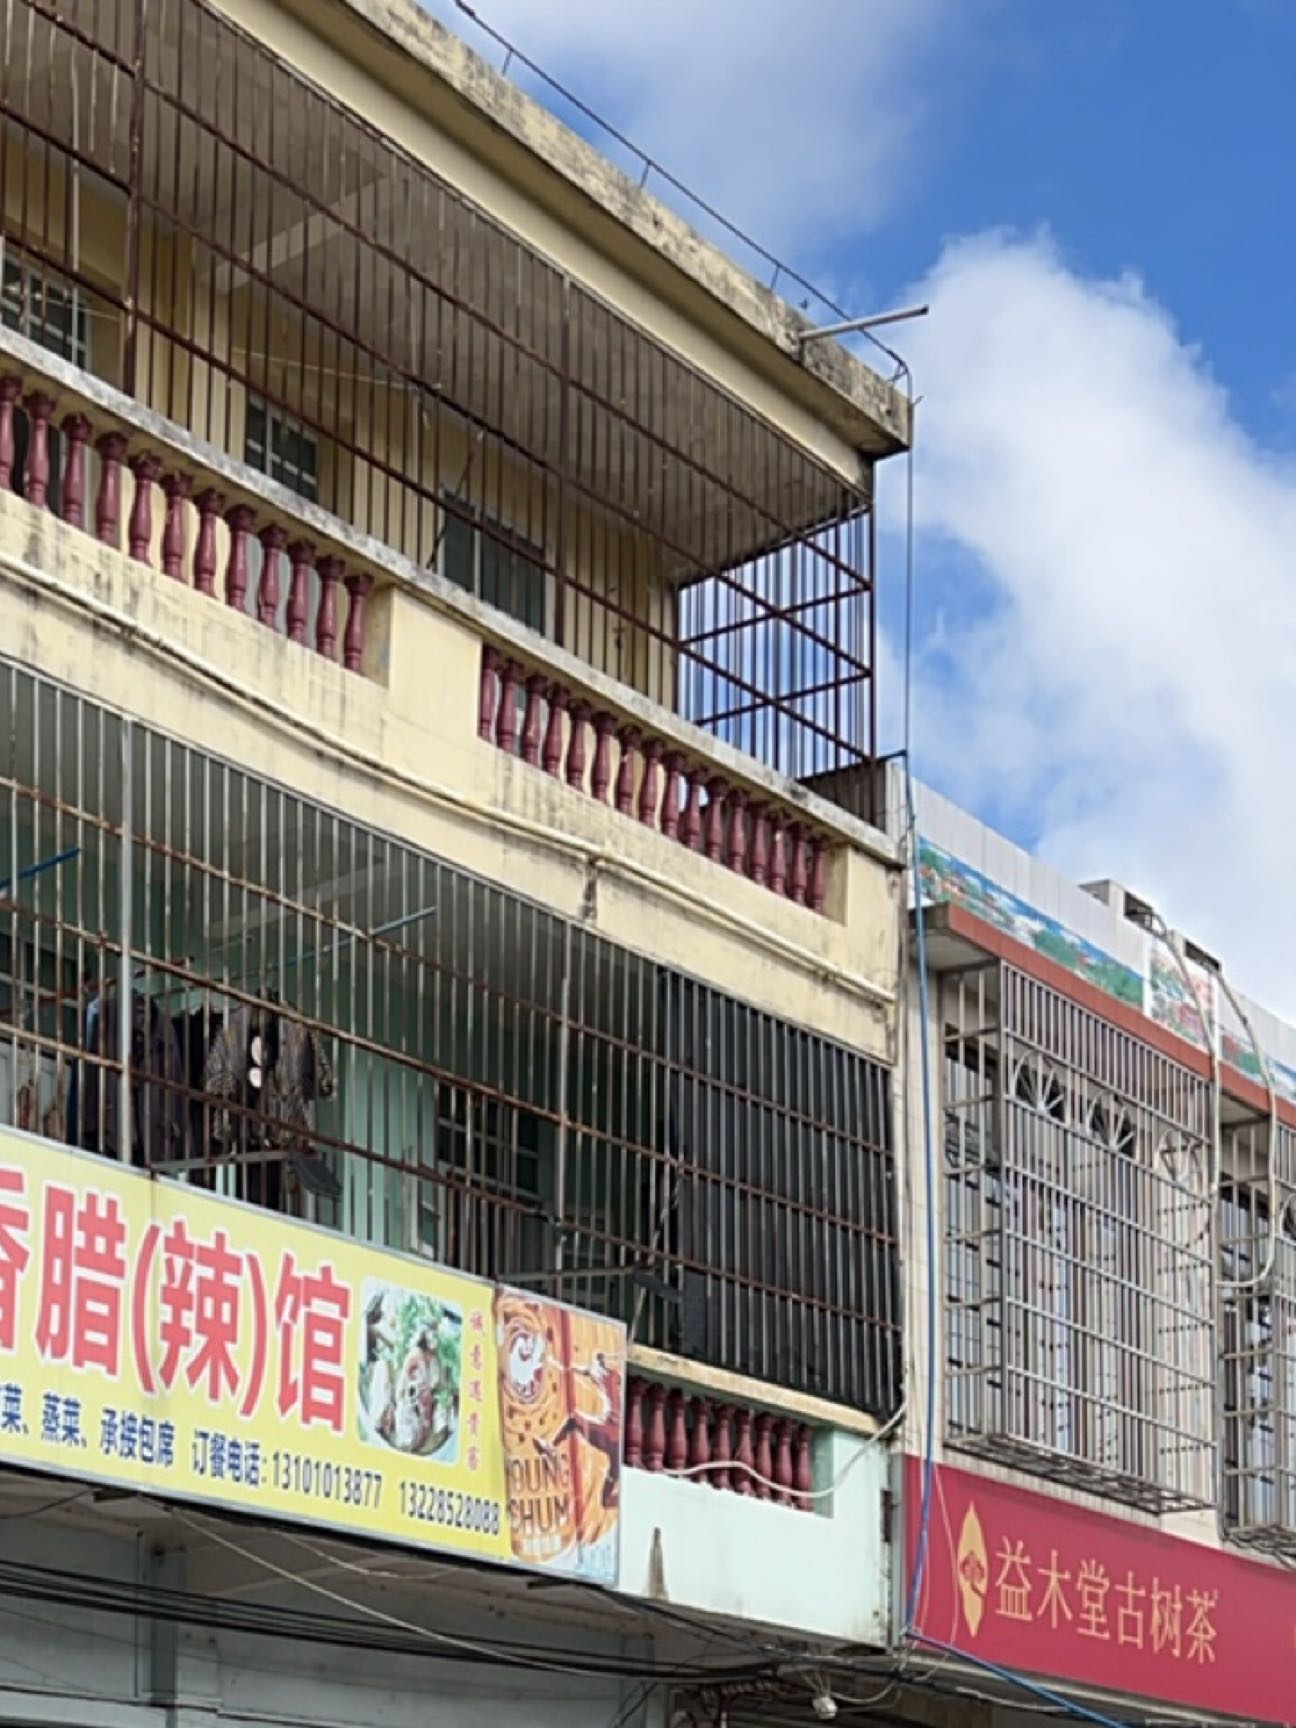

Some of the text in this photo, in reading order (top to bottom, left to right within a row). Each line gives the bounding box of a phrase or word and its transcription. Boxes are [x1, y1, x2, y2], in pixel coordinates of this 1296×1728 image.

[994, 1535, 1220, 1665] 益木堂古树茶
